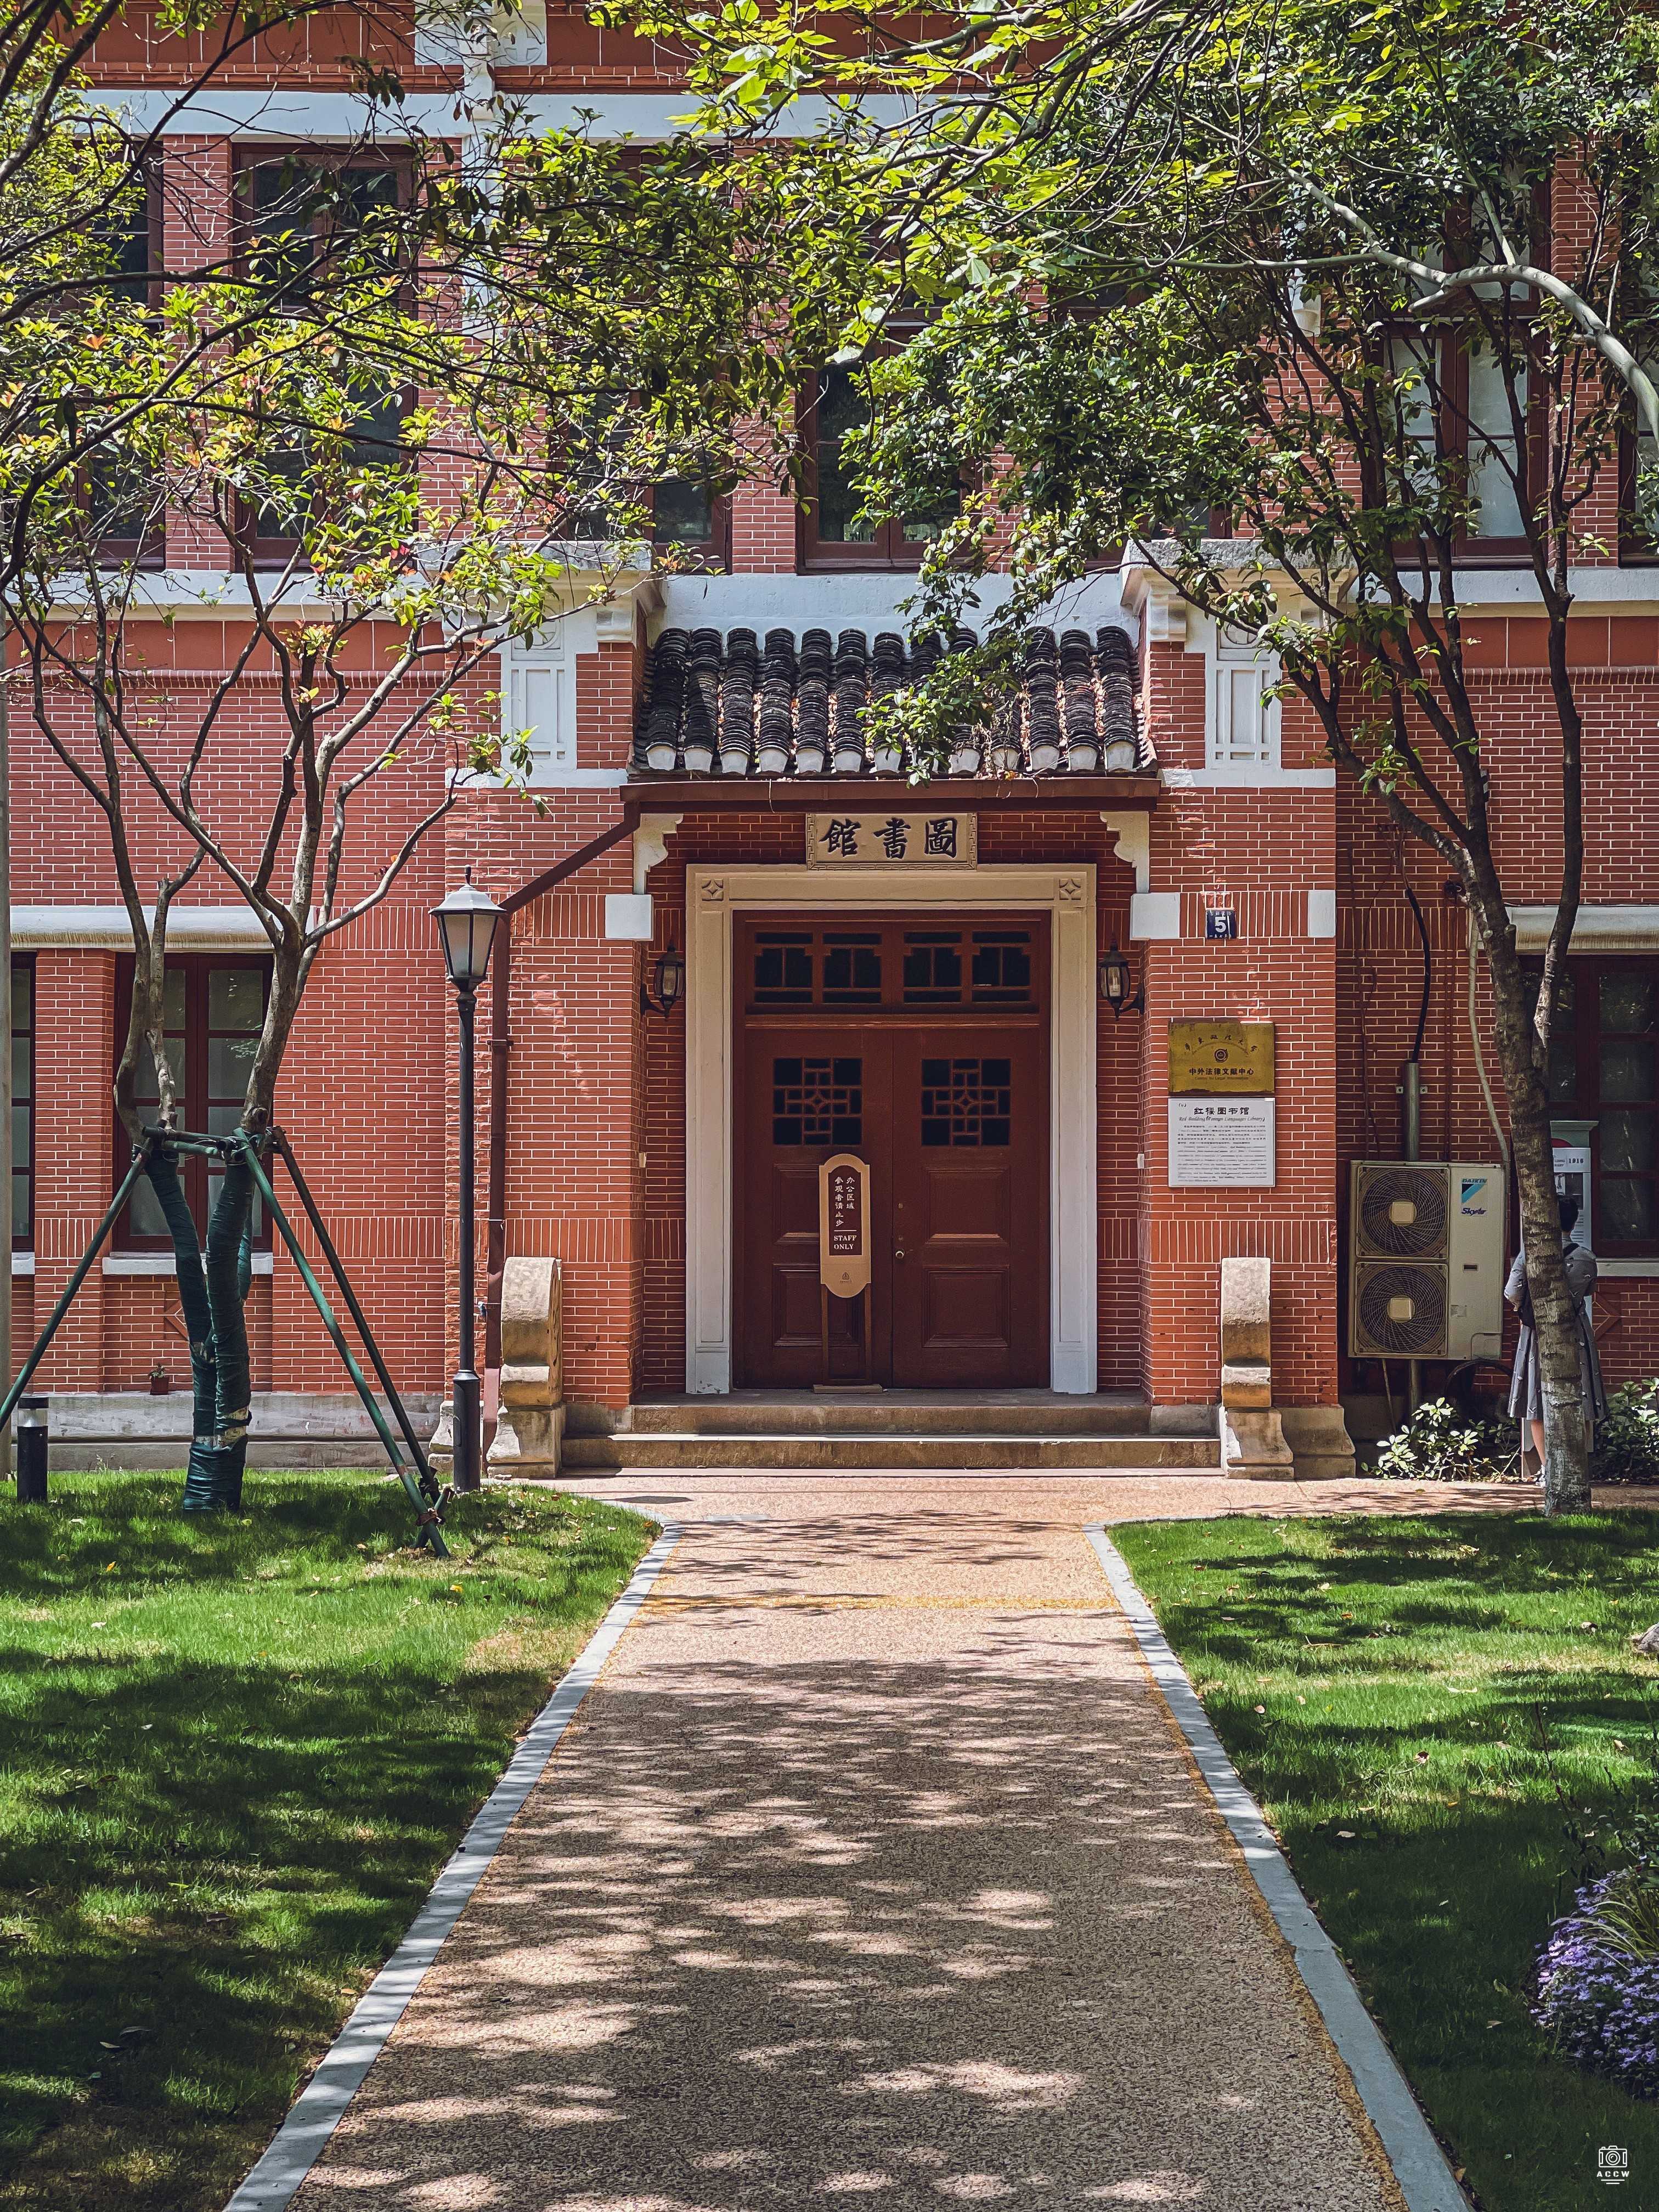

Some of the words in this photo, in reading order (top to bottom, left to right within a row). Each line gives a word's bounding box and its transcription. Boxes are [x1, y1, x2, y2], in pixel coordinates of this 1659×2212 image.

[1215, 916, 1226, 933] 5
[1194, 1107, 1250, 1115] 红楼图书馆
[834, 1176, 844, 1227] 参观者请止步
[845, 1176, 855, 1210] 办公区域
